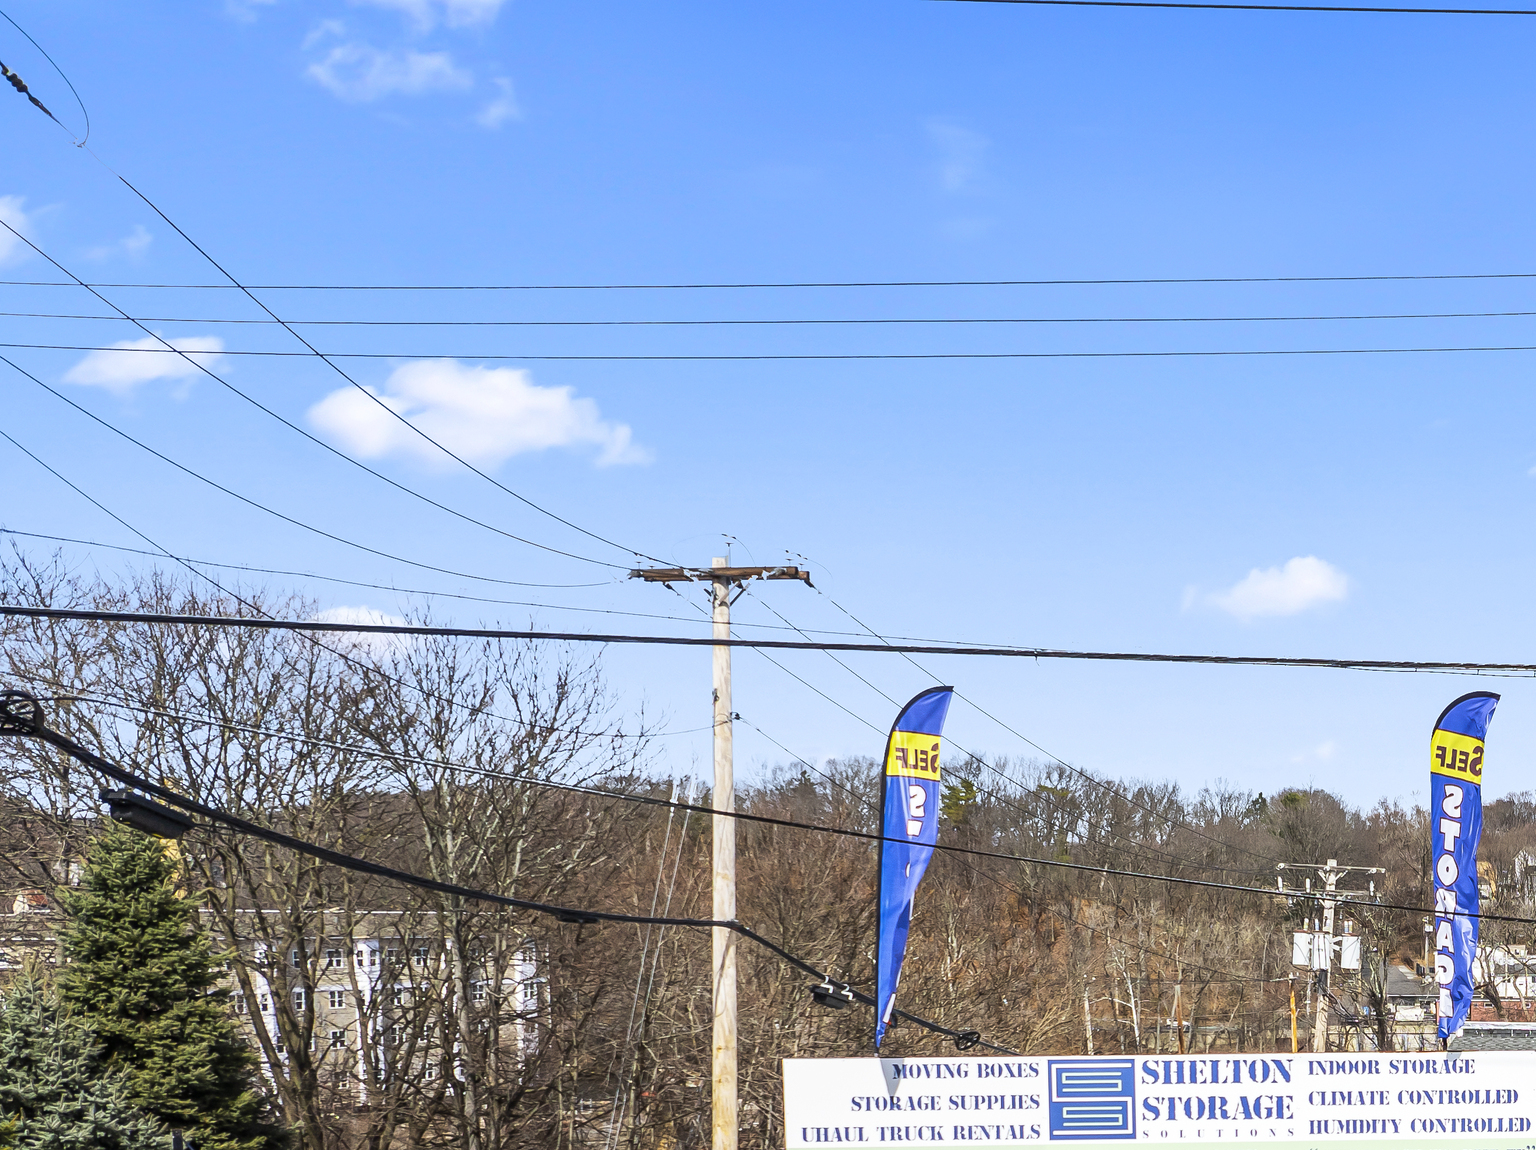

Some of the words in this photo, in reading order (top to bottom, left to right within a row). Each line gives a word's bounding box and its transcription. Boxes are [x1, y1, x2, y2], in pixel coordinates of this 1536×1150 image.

[892, 1063, 969, 1080] MOVING
[977, 1062, 1039, 1079] BOXES
[1141, 1059, 1294, 1085] SHELTON
[1308, 1059, 1381, 1075] INDOOR
[1388, 1058, 1476, 1075] STORAGE
[851, 1095, 942, 1112] STORAGE
[948, 1094, 1040, 1110] SUPPLIES
[1308, 1089, 1391, 1106] CLIMATE
[1397, 1089, 1519, 1105] CONTROLLED
[1142, 1095, 1294, 1121] STORAGE
[801, 1126, 869, 1143] UHAUL
[876, 1125, 944, 1142] TRUCK
[952, 1124, 1041, 1141] RENTALS
[1308, 1118, 1402, 1135] HUMIDITY
[1410, 1117, 1532, 1134] CONTROLLED
